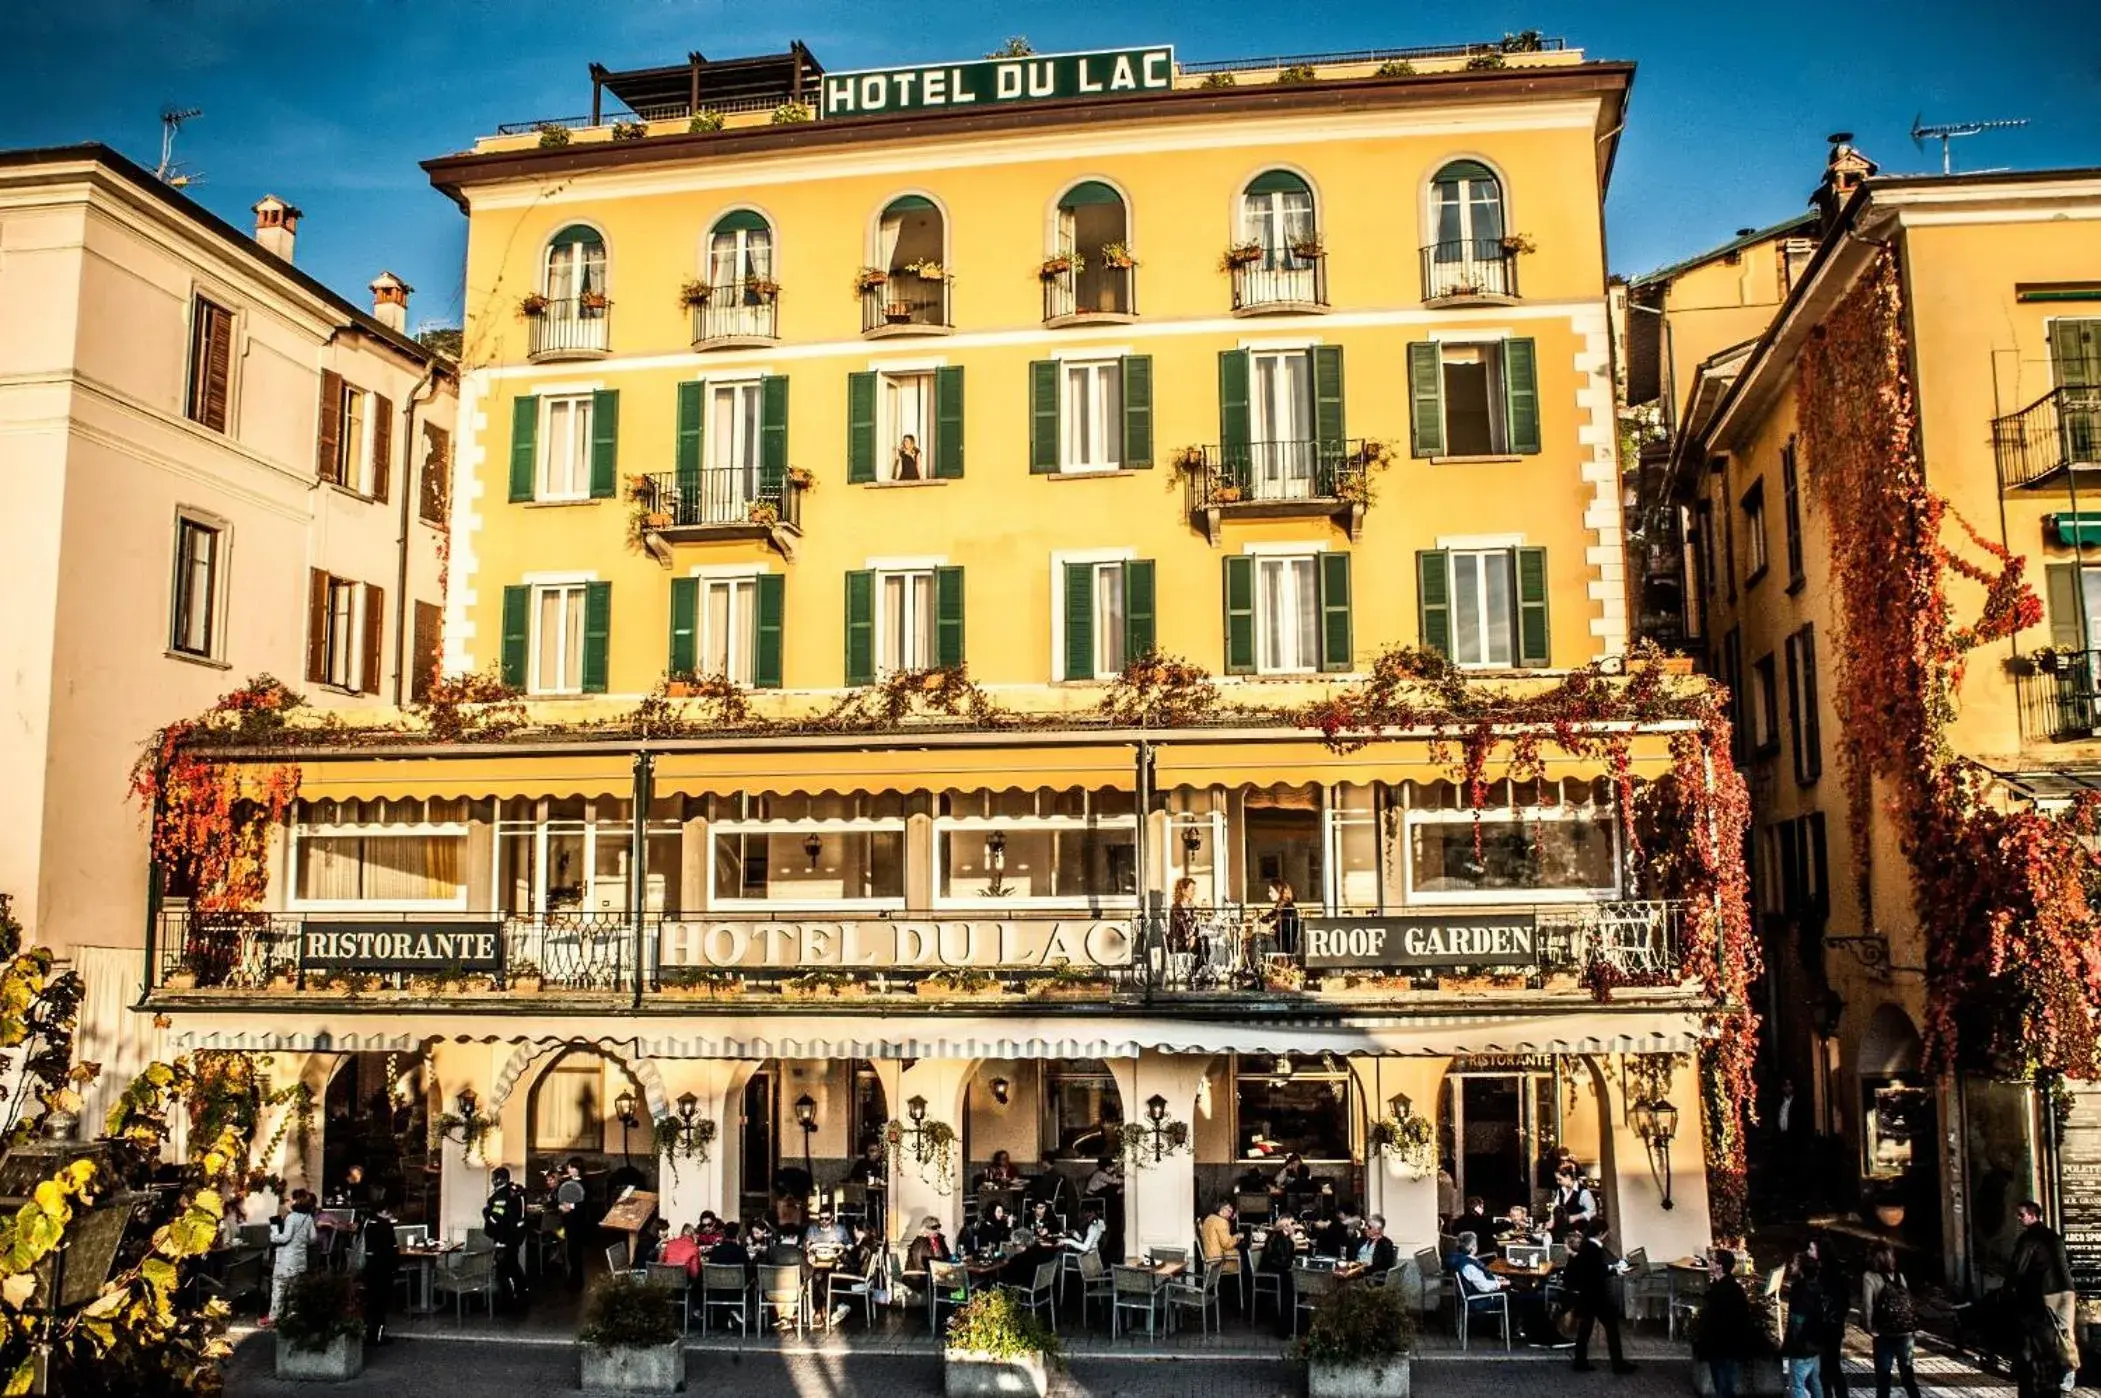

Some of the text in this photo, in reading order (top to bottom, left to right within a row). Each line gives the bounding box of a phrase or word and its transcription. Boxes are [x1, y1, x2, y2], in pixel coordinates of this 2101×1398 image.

[828, 52, 1167, 113] HOTEL DU LAC
[305, 932, 495, 960] RISTORANTE
[660, 921, 1131, 967] HOTEL DU LAC
[1306, 926, 1534, 958] ROOF GARDEN
[1469, 1053, 1551, 1066] RISTORANTE
